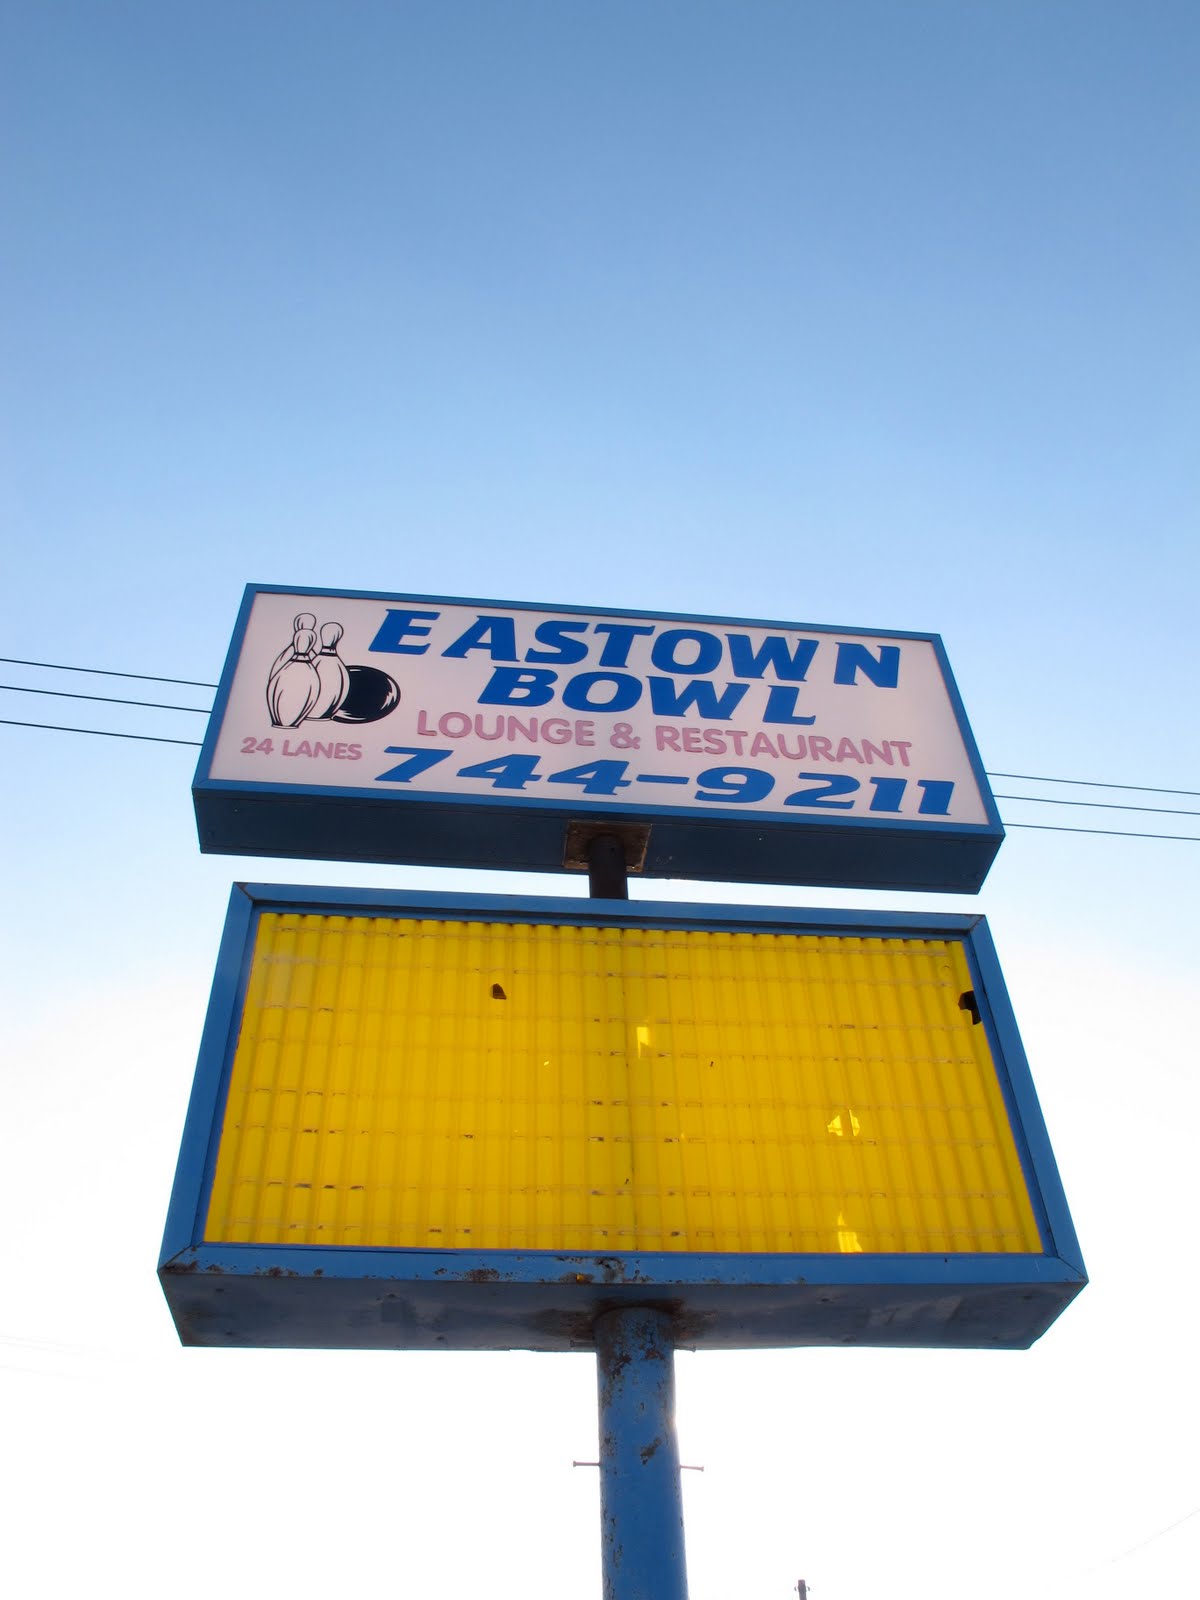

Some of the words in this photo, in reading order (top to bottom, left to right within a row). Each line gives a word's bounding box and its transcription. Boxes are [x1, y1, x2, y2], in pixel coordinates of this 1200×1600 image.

[368, 608, 901, 689] EASTOWN
[477, 666, 816, 726] BOWL
[239, 736, 274, 756] 24
[281, 739, 363, 761] LANES
[416, 709, 596, 747] LOUNGE
[609, 721, 641, 750] &
[655, 725, 913, 768] RESTAURANT
[374, 745, 955, 816] 744-9211
